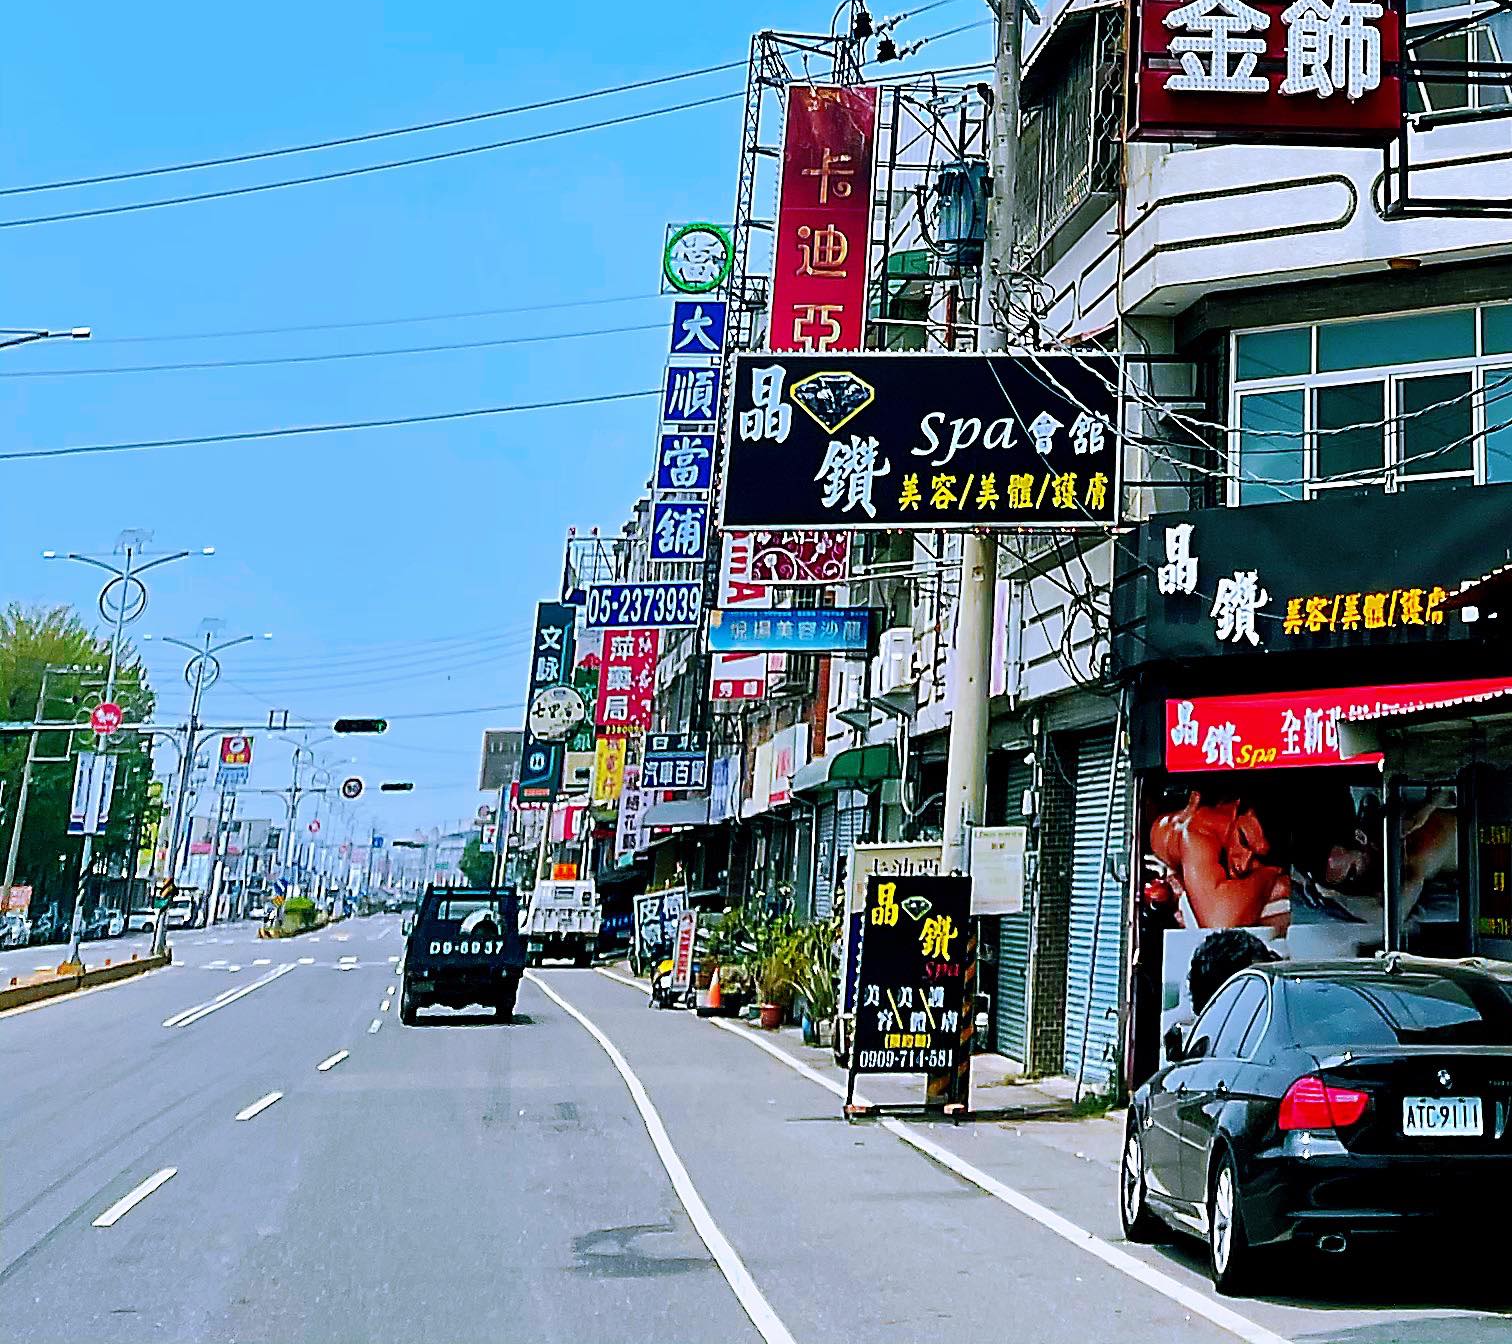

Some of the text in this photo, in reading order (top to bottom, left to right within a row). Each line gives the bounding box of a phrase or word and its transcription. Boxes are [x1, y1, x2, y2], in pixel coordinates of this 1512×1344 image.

[655, 306, 719, 556] 大順當舖
[1237, 744, 1278, 768] Spa
